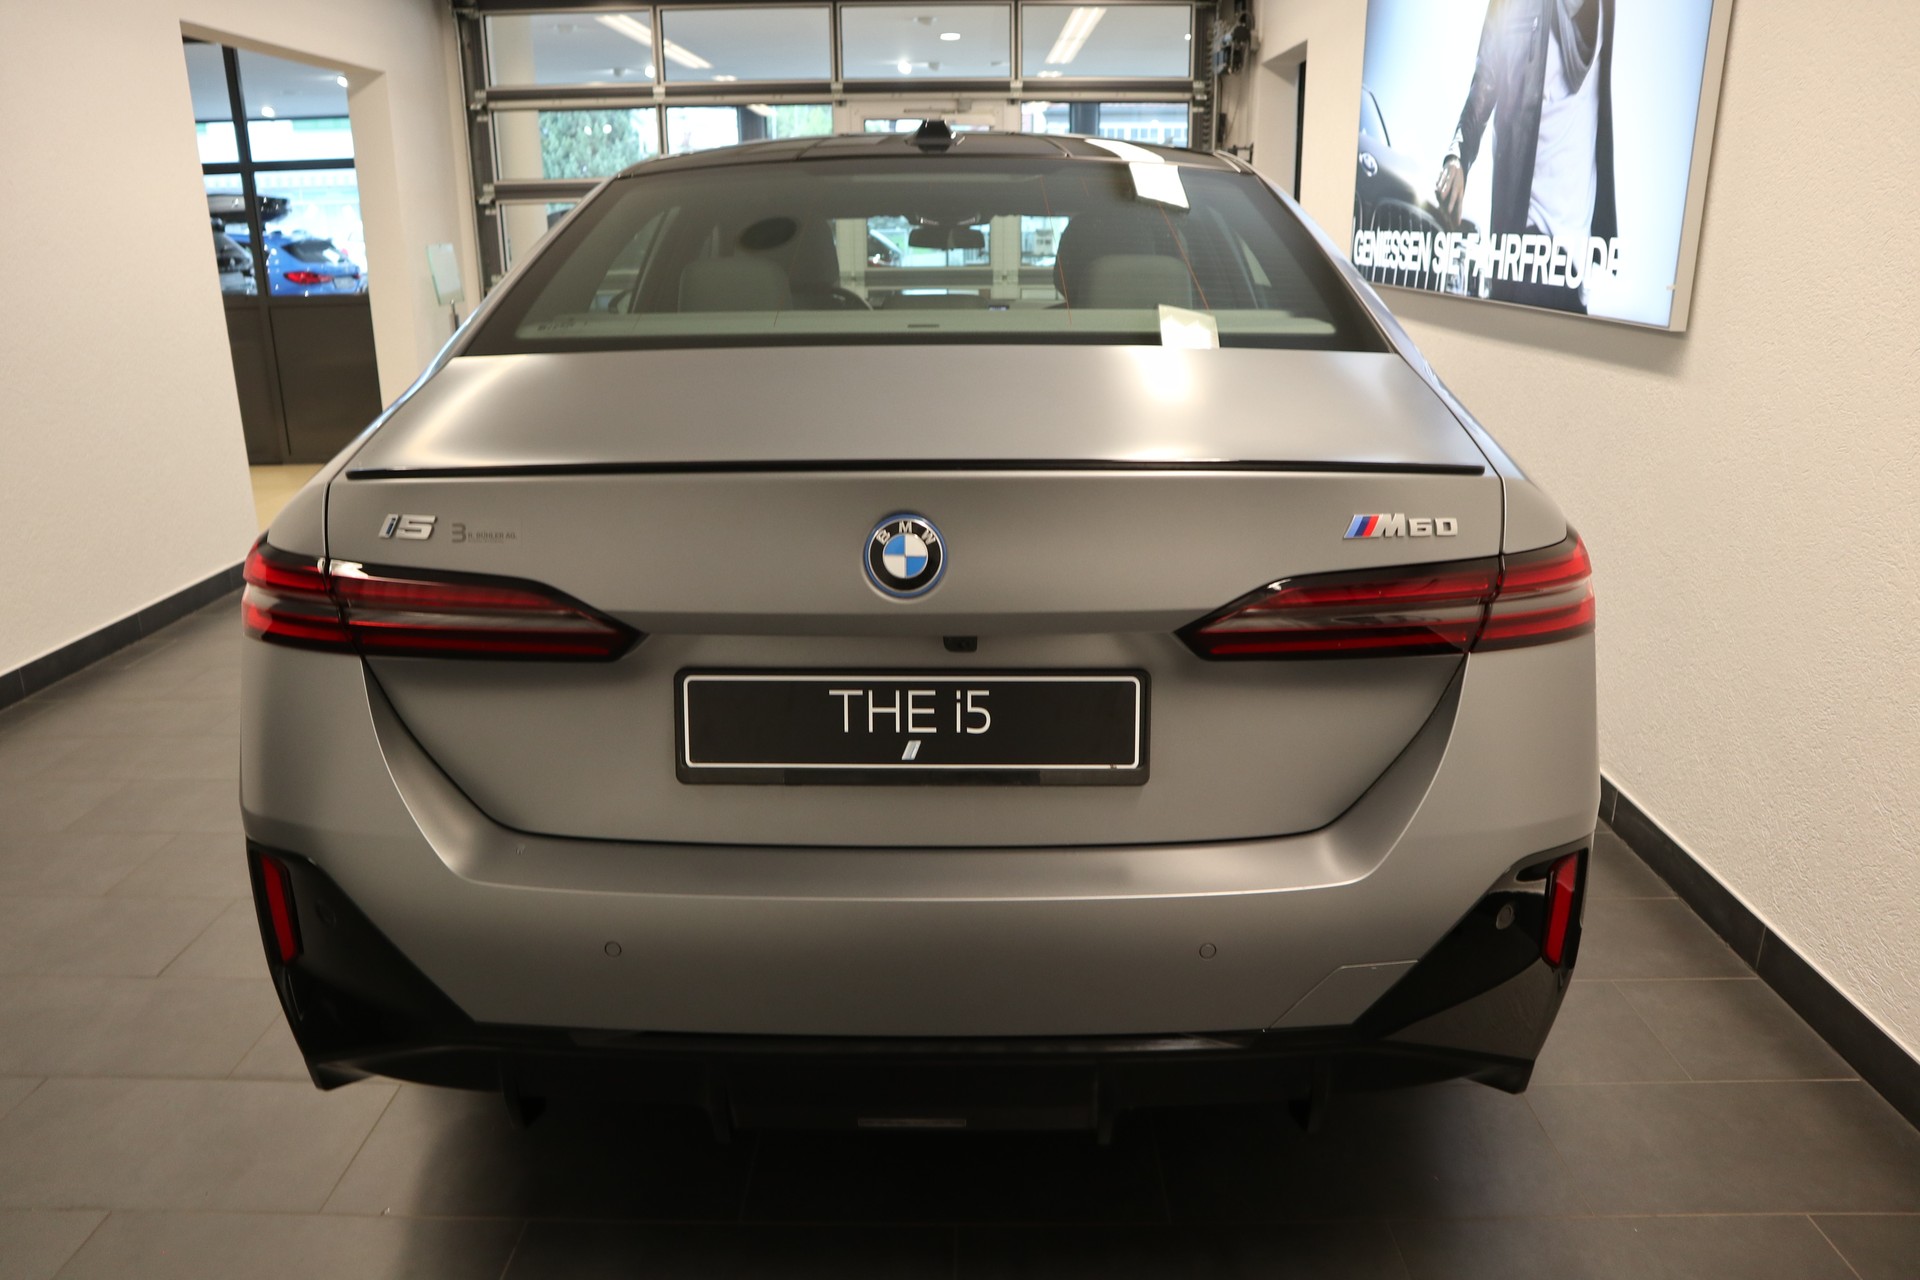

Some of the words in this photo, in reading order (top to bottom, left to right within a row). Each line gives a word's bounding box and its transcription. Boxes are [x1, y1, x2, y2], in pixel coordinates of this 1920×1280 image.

[1353, 229, 1432, 272] GENIESSEN
[1432, 230, 1463, 275] SIE
[828, 689, 938, 734] THE
[955, 689, 992, 734] i5
